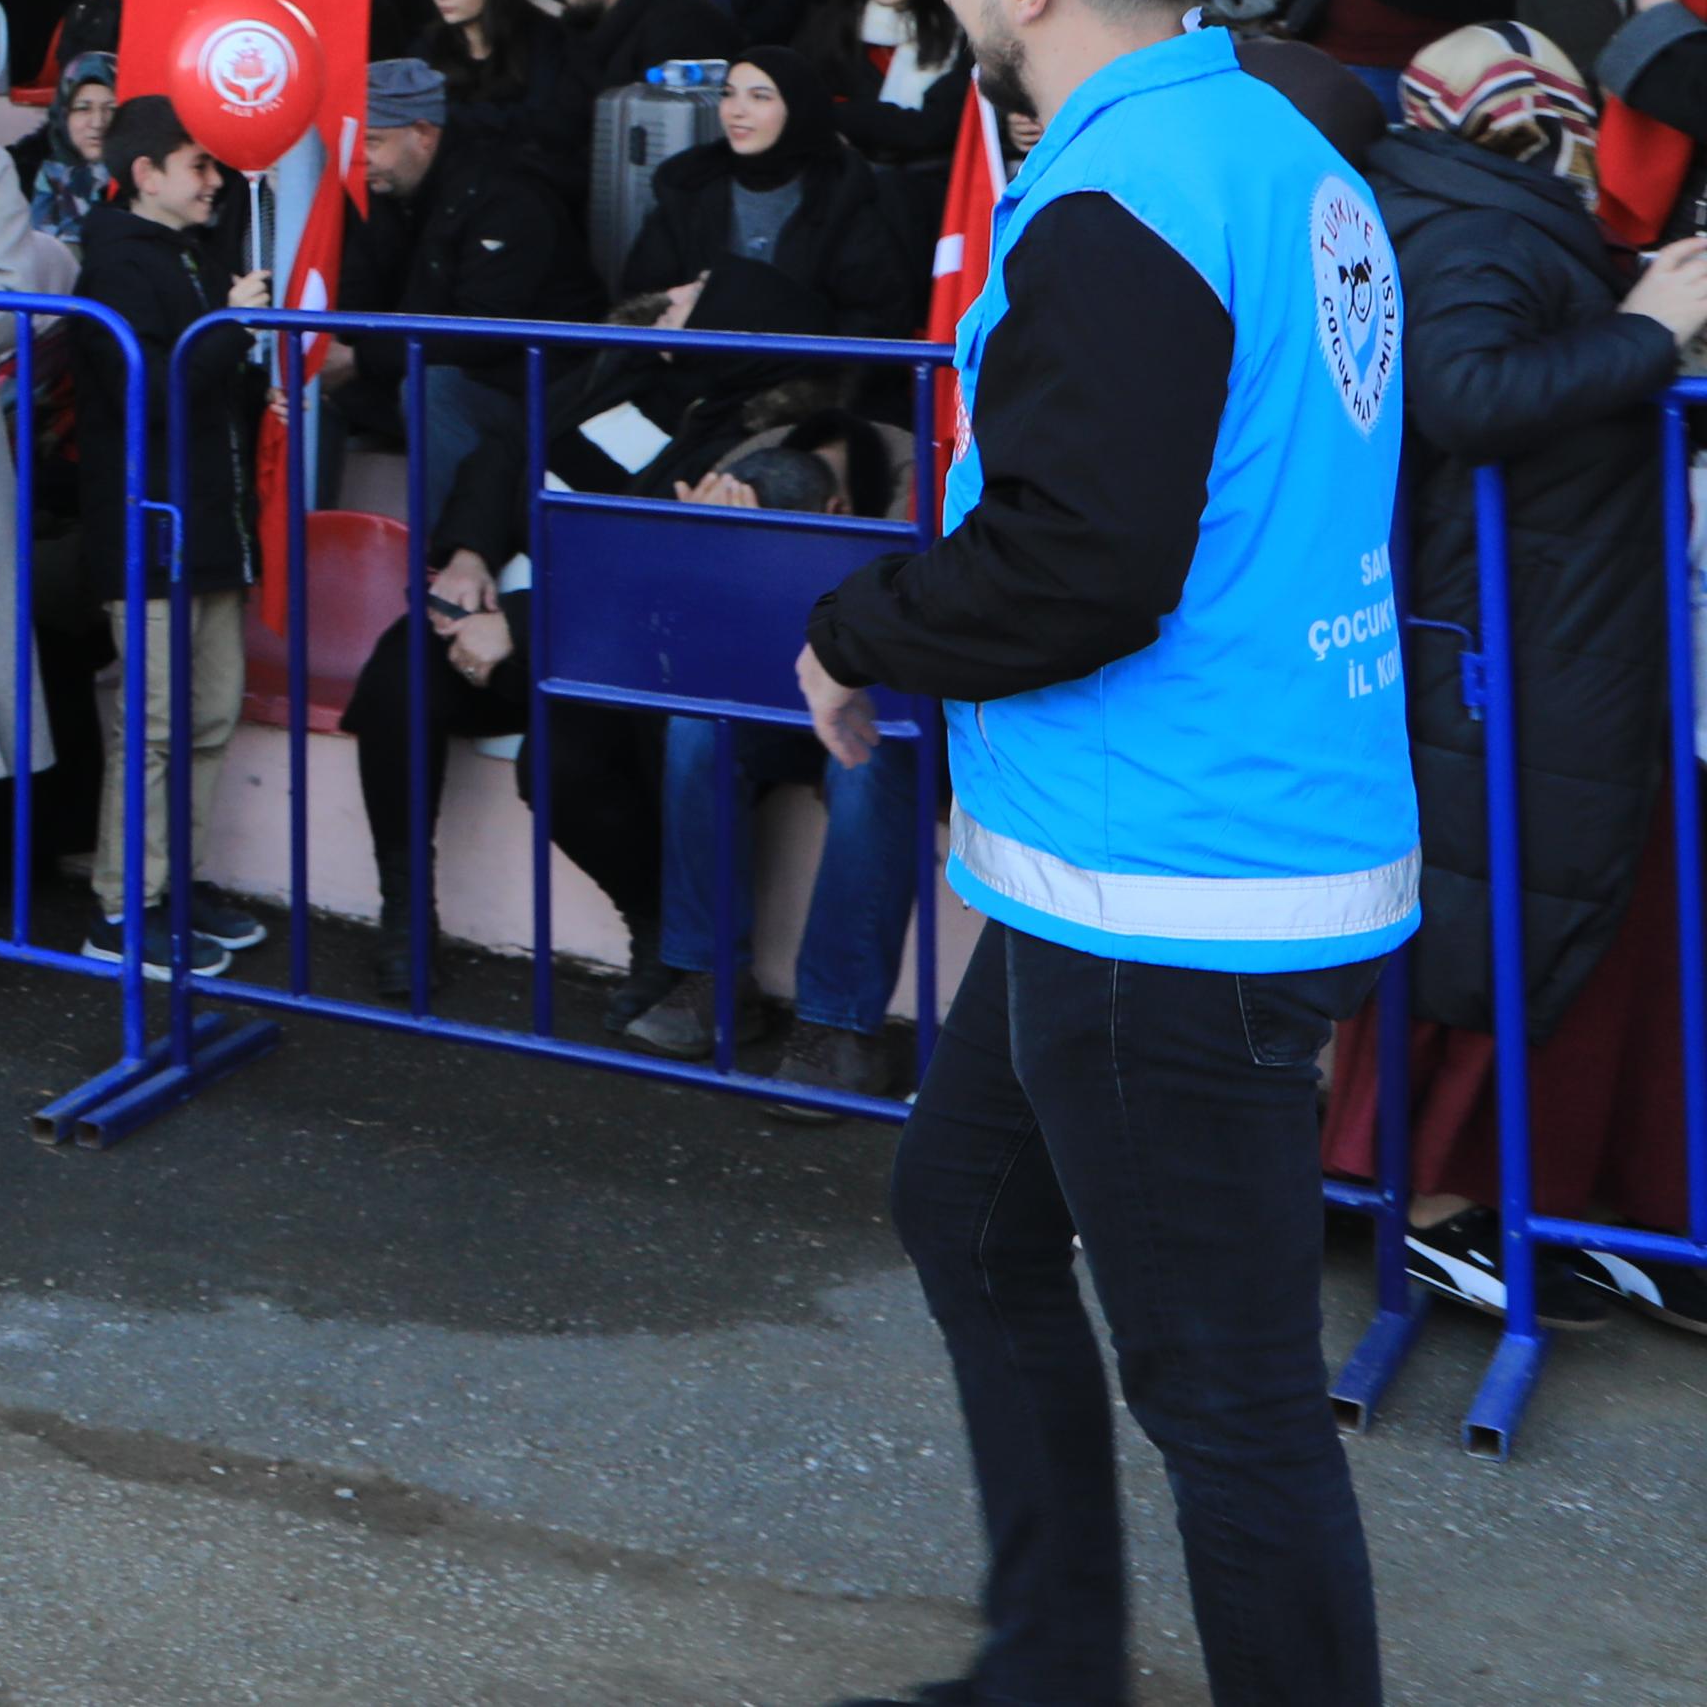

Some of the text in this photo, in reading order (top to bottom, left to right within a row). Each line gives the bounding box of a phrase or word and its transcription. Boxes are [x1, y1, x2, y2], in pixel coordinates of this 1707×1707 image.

[1320, 197, 1373, 257] TÜRKİYE
[1322, 295, 1351, 396] ÇOCUK
[1308, 598, 1392, 661] ÇOCUK
[1348, 646, 1401, 699] İL KO
